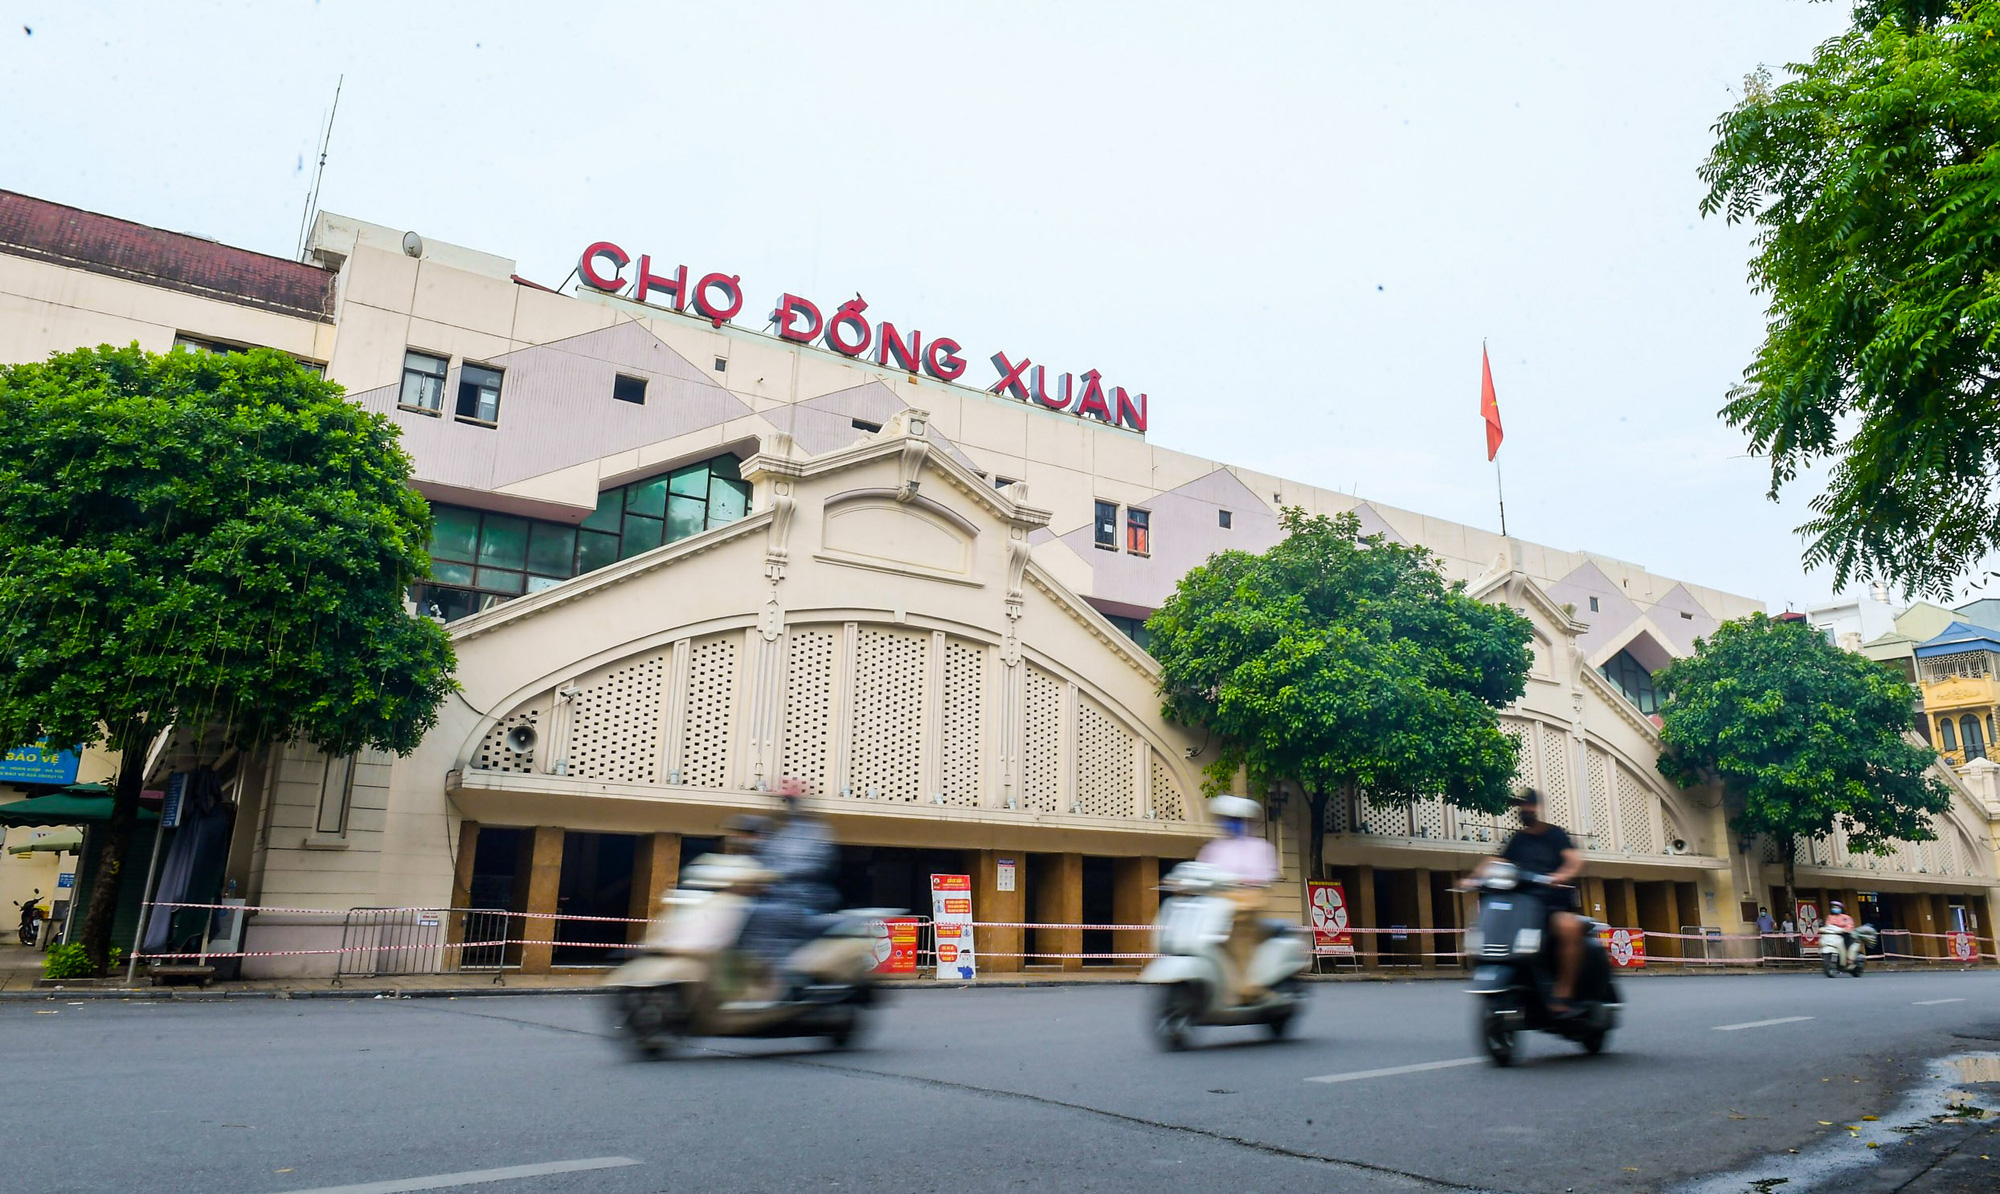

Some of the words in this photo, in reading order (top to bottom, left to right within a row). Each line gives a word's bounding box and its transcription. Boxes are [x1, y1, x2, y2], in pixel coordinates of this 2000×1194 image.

[577, 242, 743, 328] CHỢ
[990, 350, 1147, 431] XUÂN
[5, 750, 37, 762] BẢO
